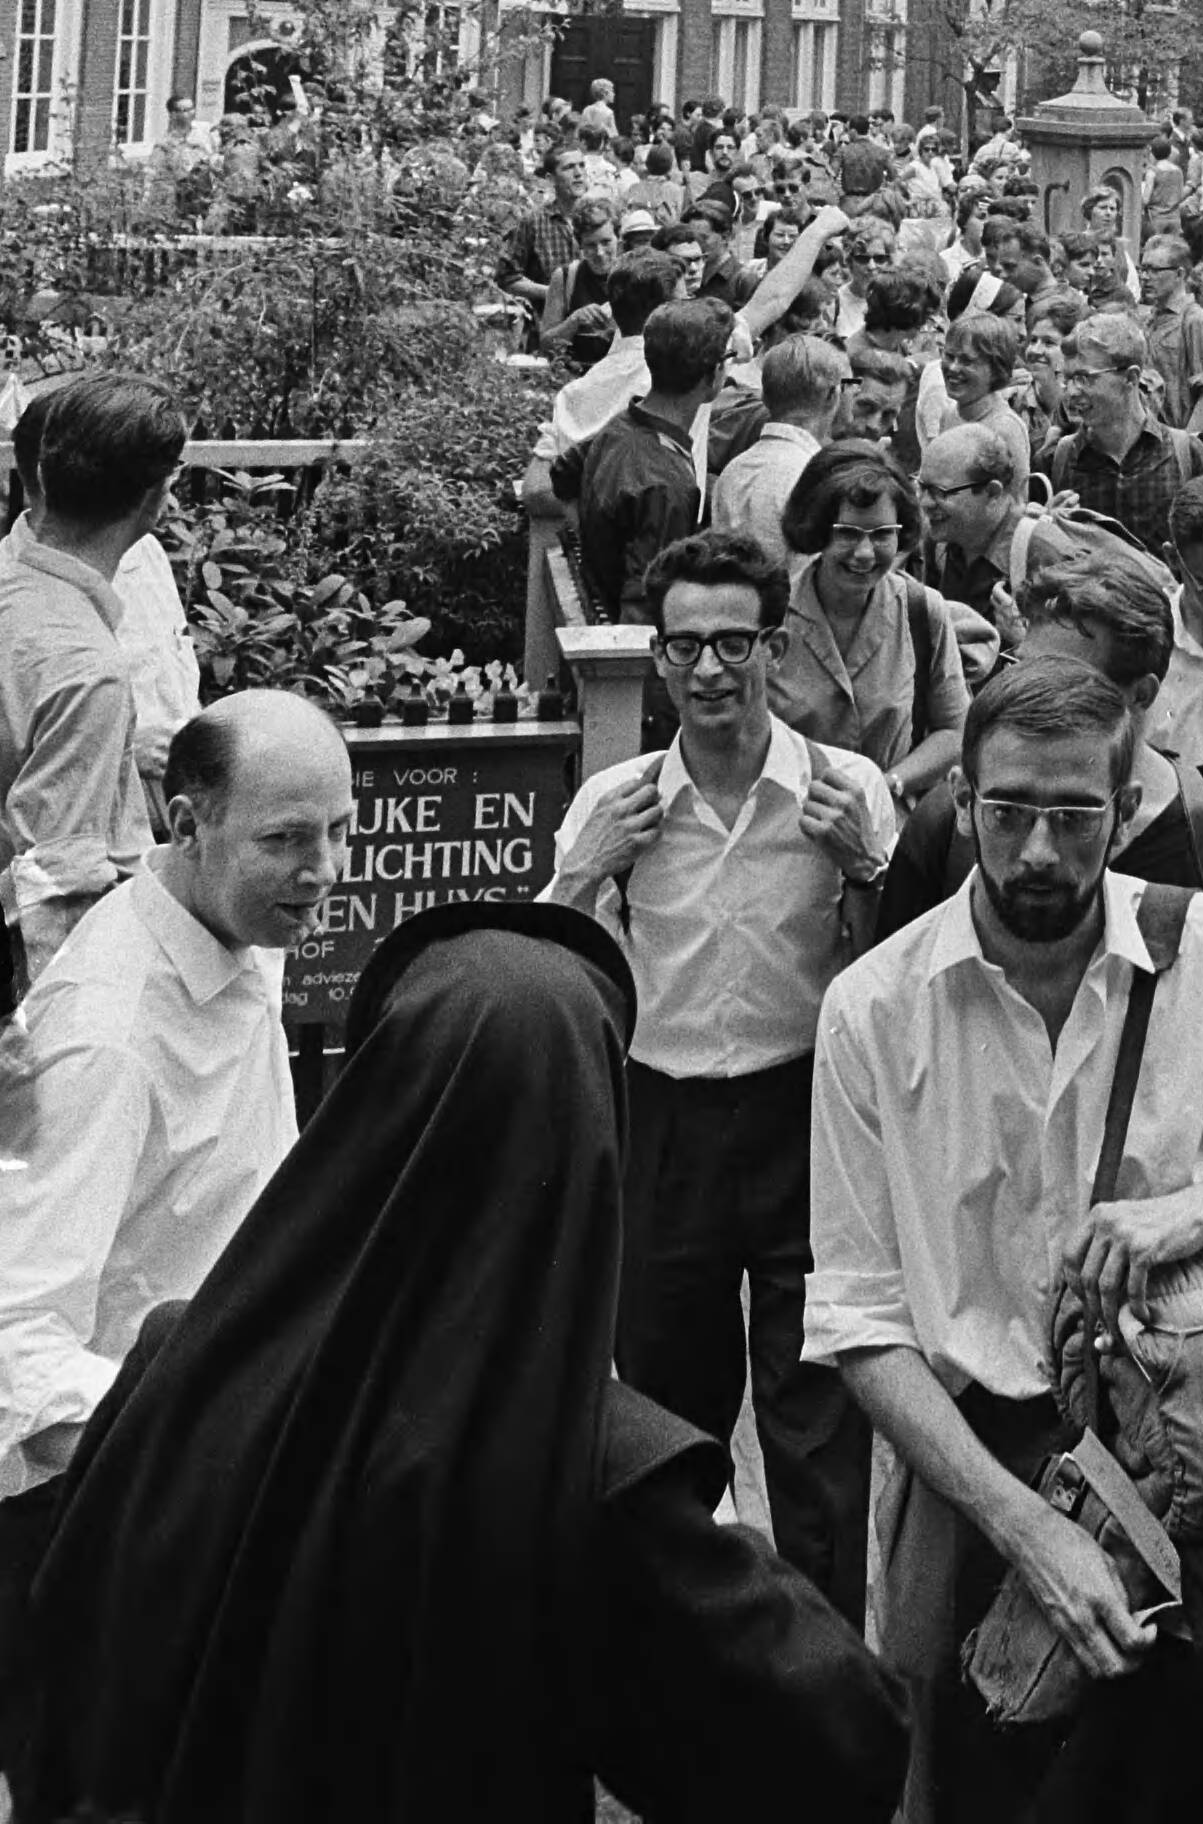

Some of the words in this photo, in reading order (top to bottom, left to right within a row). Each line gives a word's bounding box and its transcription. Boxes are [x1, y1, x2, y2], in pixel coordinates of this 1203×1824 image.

[351, 770, 375, 787] IE
[394, 768, 458, 786] VOOR
[474, 792, 536, 829] EN
[342, 838, 533, 883] LICHTING
